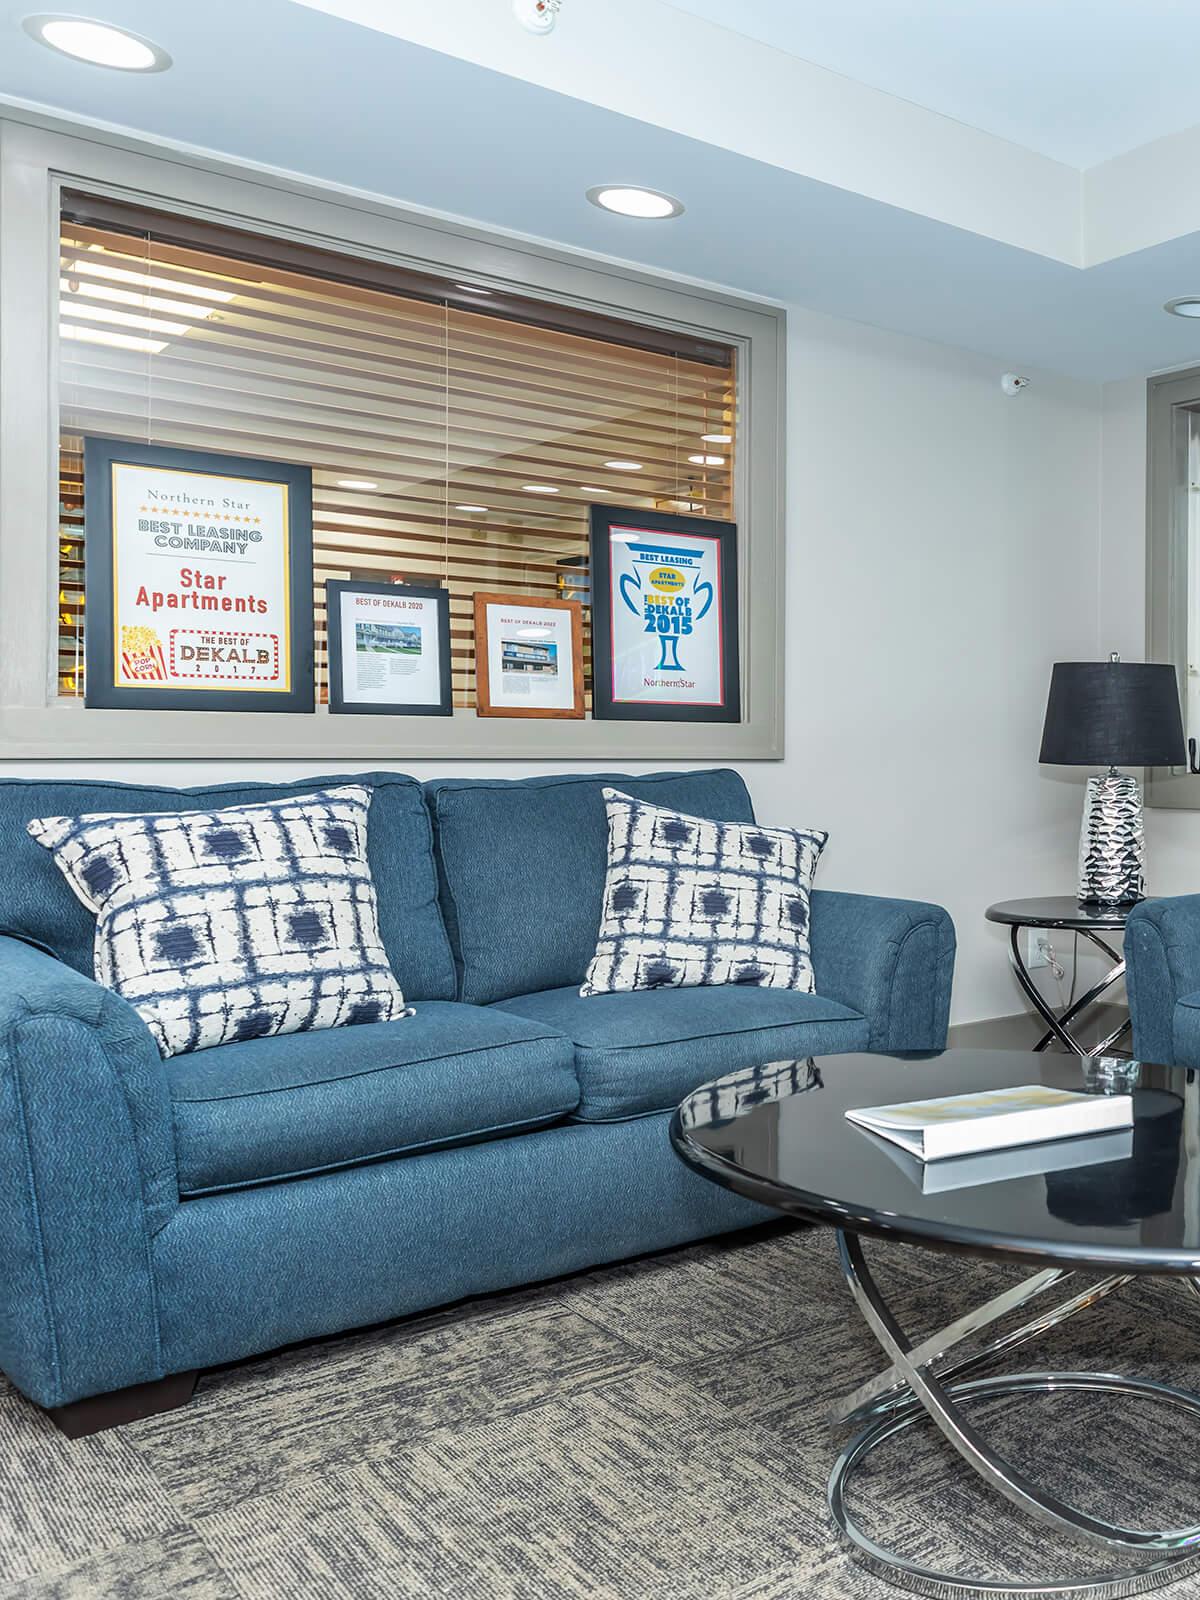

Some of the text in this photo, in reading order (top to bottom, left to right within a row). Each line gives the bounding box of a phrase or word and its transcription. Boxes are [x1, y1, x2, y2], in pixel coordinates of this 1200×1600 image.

[147, 489, 251, 510] Northern Star
[138, 519, 263, 542] BEST LEASING
[154, 535, 248, 555] COMPANY
[640, 553, 693, 565] BEST LEASING
[180, 568, 227, 590] Star
[136, 586, 268, 614] Apartments
[383, 600, 406, 608] DEKALB
[648, 595, 674, 606] BEST
[675, 597, 690, 607] OF
[648, 604, 692, 616] DEKALB
[644, 614, 693, 635] 2015
[201, 636, 250, 646] THE BEST OF
[180, 645, 270, 665] DEKALB
[680, 679, 695, 689] Star
